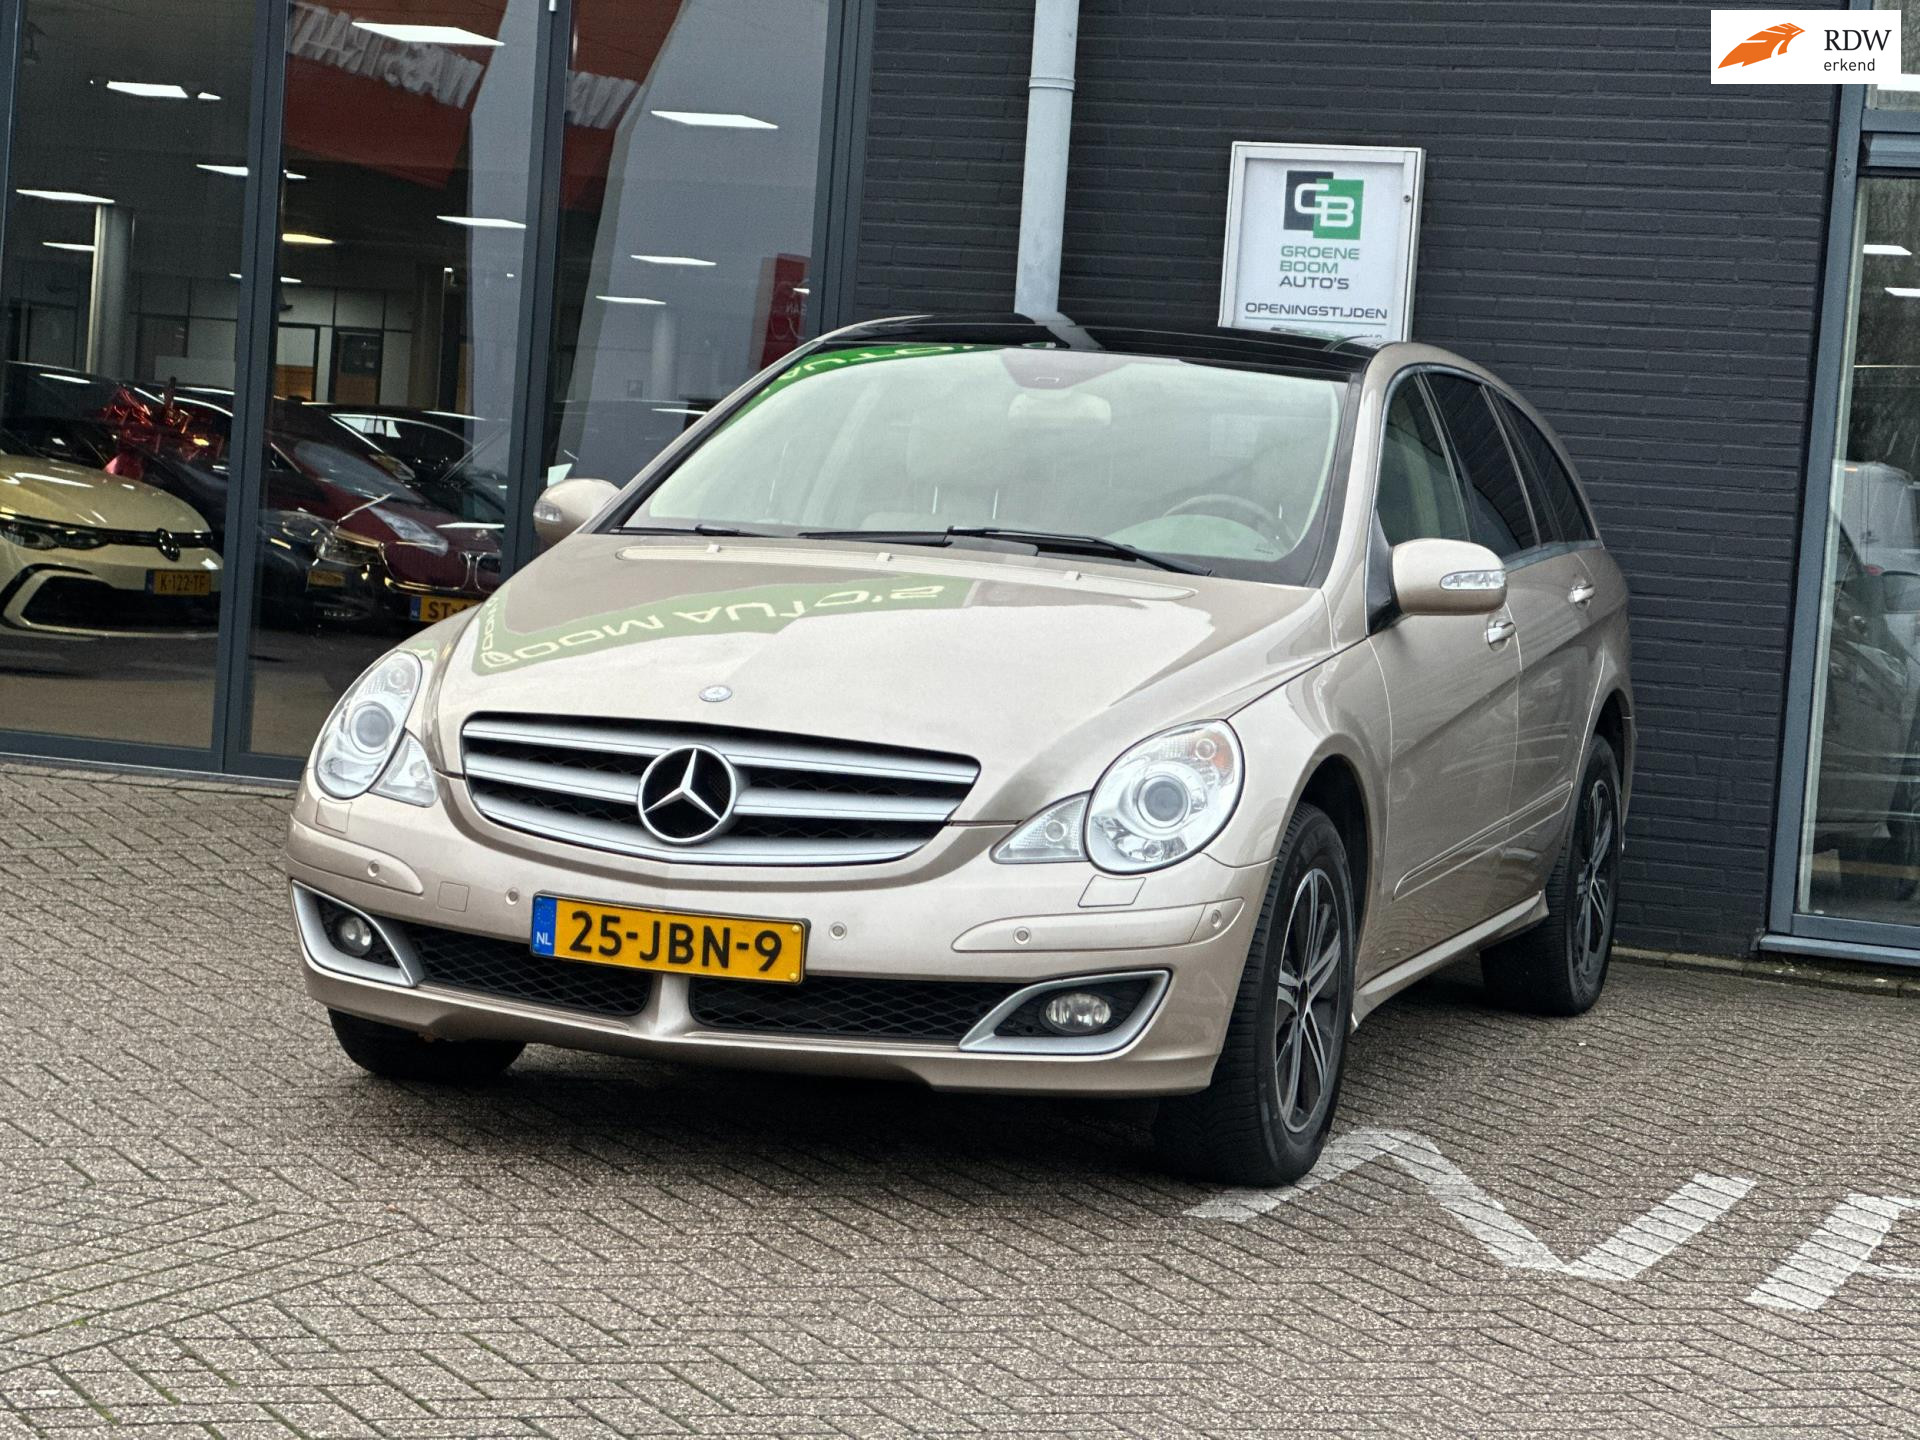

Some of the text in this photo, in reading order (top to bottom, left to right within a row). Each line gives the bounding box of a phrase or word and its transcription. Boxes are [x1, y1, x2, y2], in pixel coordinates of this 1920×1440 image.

[1281, 245, 1360, 260] GROENE
[1279, 260, 1339, 275] BOOM
[1279, 276, 1350, 290] AUTO'S
[1245, 302, 1388, 319] OPENINGSTIJDEN
[535, 910, 783, 972] NL 25-JBN-9
